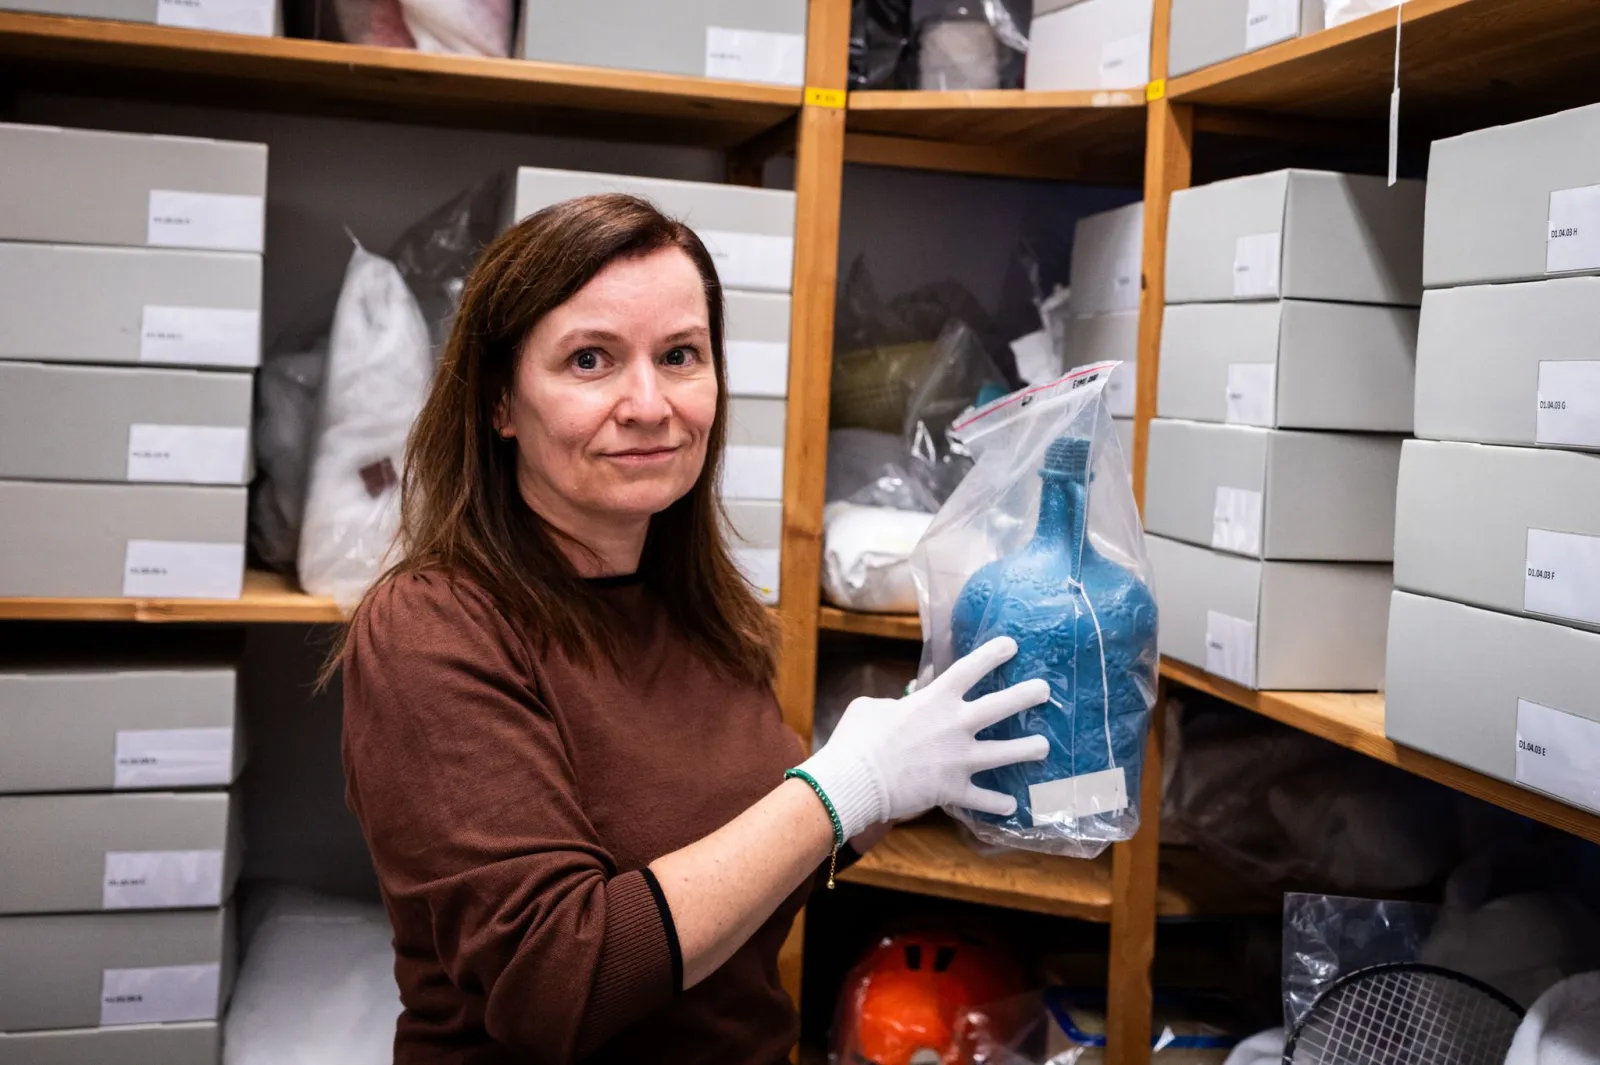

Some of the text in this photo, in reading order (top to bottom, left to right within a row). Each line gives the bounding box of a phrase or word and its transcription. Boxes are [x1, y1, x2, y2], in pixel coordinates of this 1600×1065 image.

[1551, 228, 1572, 238] D1.04.03
[1540, 400, 1560, 409] D1.04.03
[1528, 568, 1550, 579] D1.04.03
[1519, 740, 1541, 755] D1.04.03
